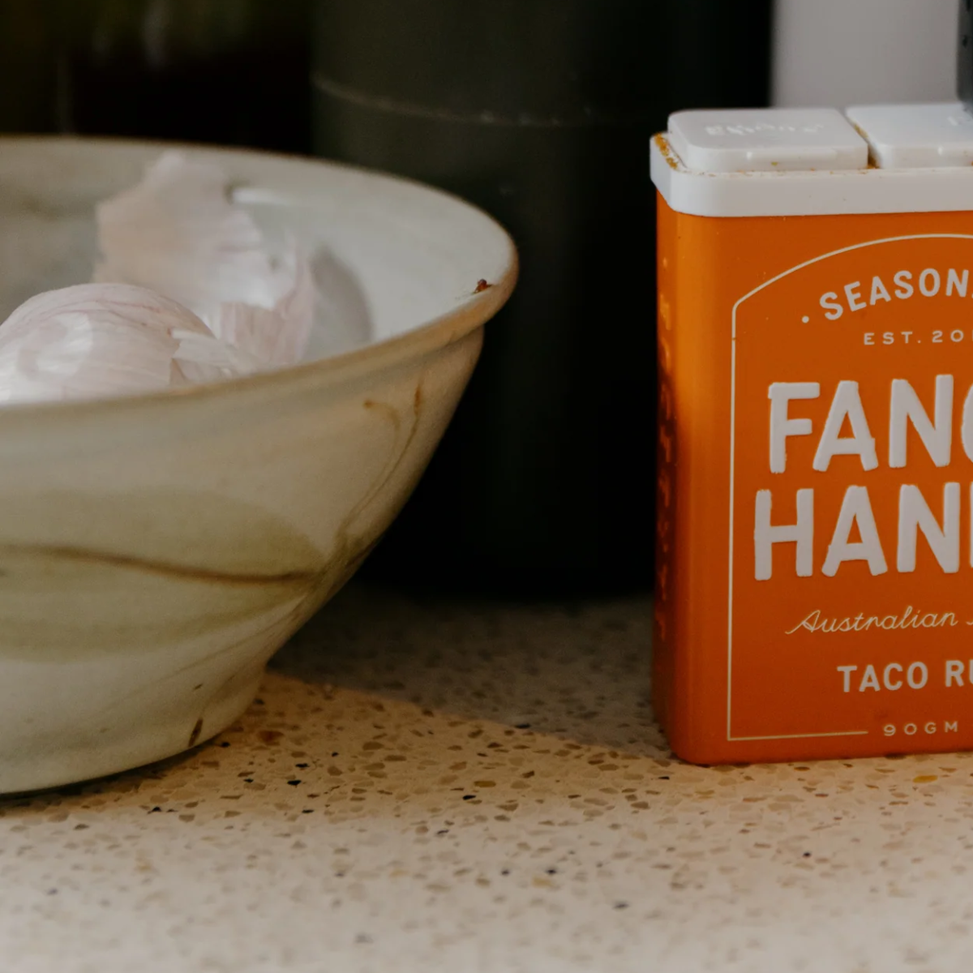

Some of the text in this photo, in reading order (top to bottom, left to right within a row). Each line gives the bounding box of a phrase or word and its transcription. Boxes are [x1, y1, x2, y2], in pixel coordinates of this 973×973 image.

[784, 604, 959, 635] Australian
[836, 661, 929, 693] TACO
[883, 720, 959, 737] 90GM
